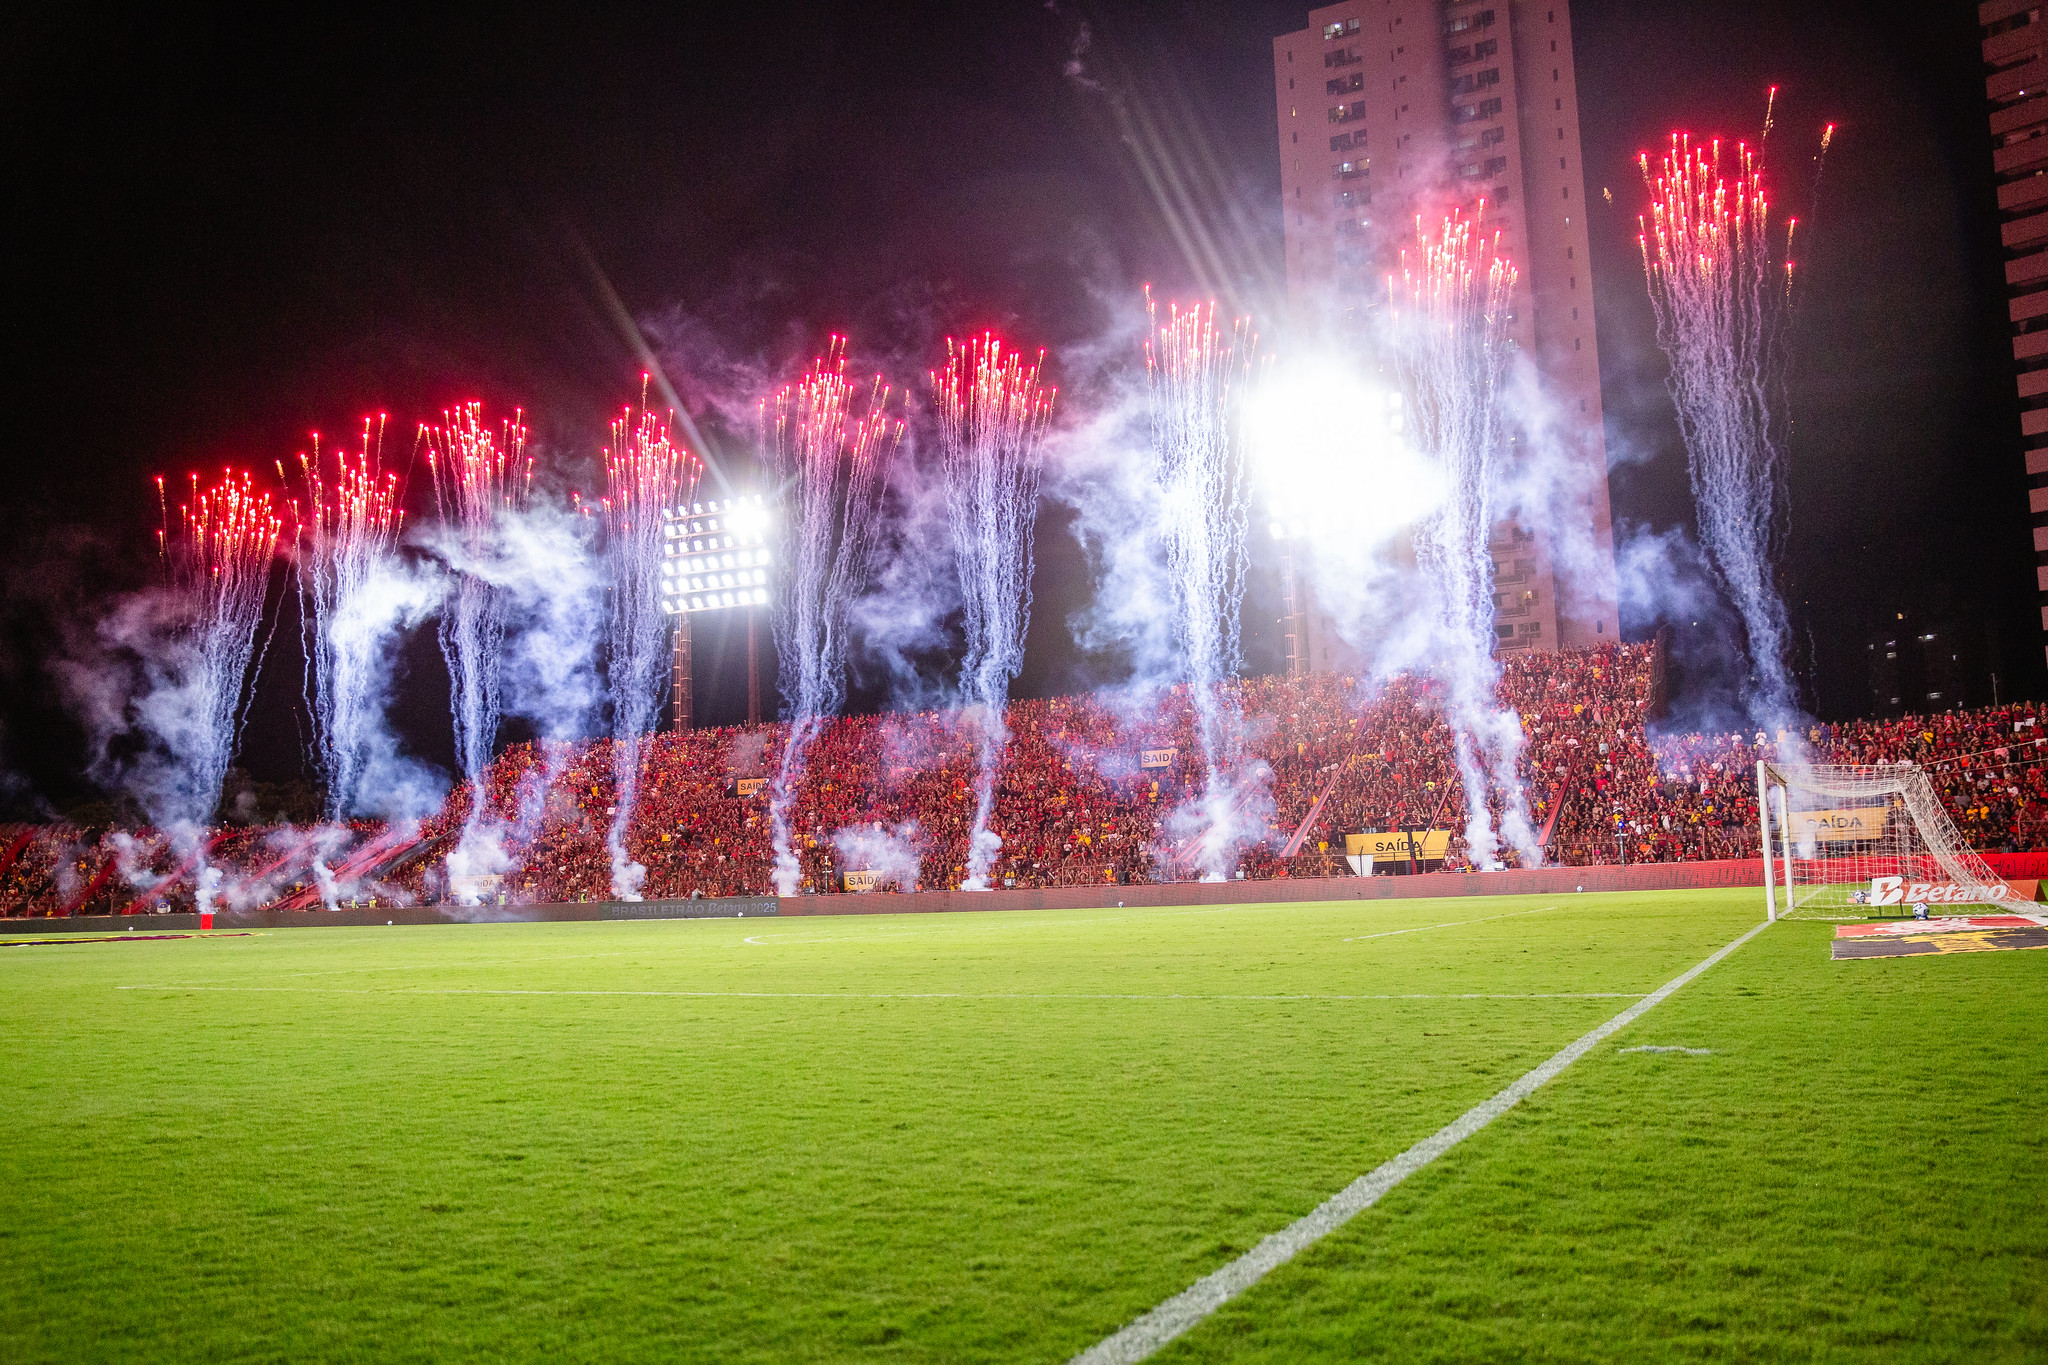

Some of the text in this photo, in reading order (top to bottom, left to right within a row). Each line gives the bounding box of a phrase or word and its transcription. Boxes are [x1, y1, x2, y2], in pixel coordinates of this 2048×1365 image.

[1375, 838, 1420, 851] SAÍDA
[1711, 866, 1768, 886] JUNT
[1905, 884, 2007, 902] Betano
[612, 902, 776, 916] BRASILEIRÃO Betano 2025
